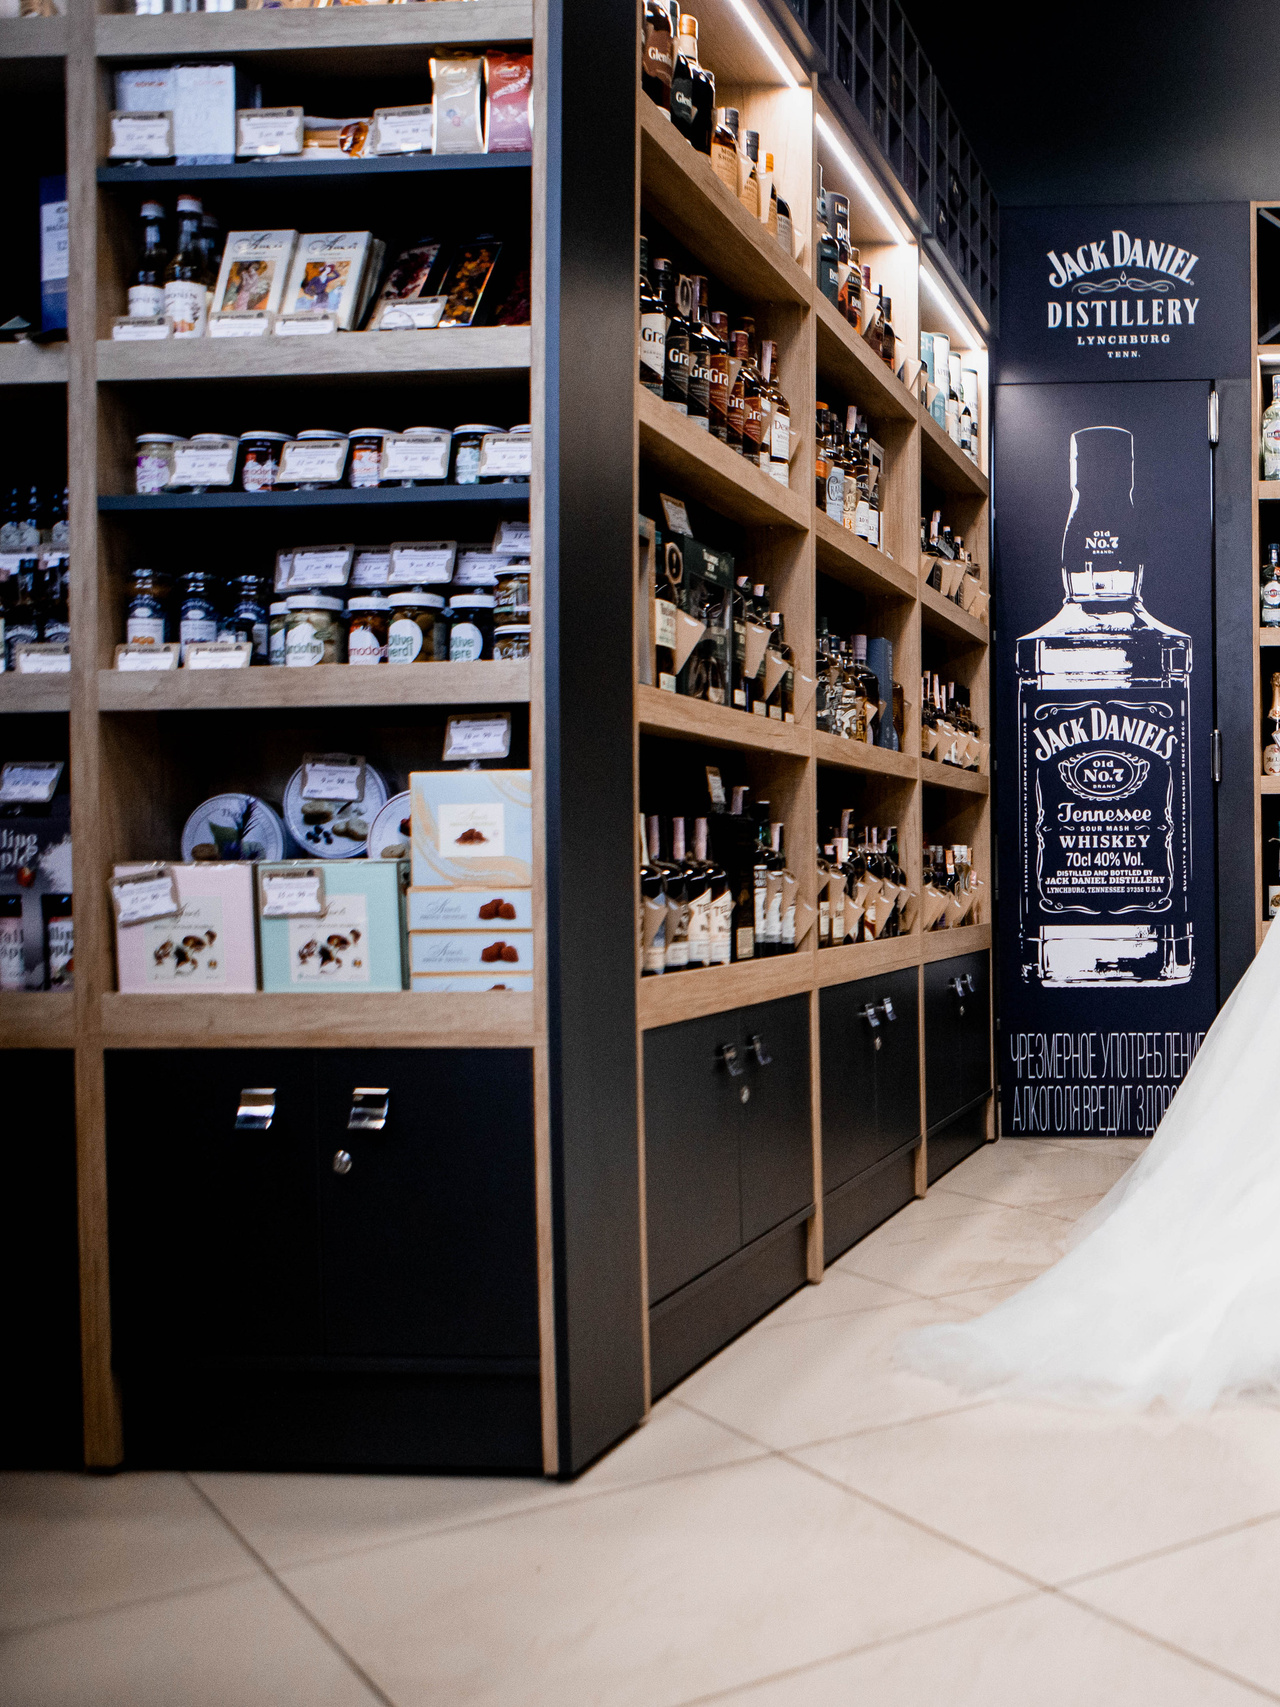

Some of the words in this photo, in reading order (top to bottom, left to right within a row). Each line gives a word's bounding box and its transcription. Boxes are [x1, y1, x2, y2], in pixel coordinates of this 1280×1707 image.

[1047, 240, 1110, 288] JACK
[1112, 230, 1200, 284] DANIEL
[1048, 298, 1200, 328] DISTILLERY
[1077, 334, 1170, 346] LYNCHBURG
[1033, 717, 1090, 761] JACK
[1090, 708, 1178, 760] DANIEL'S
[1093, 760, 1114, 768] Old
[1083, 768, 1124, 782] No.7
[1058, 802, 1152, 822] Tennessee
[1058, 834, 1151, 848] WHISKEY
[1066, 852, 1091, 867] 70cl
[1094, 852, 1120, 866] 40%
[1122, 852, 1144, 866] Vol.
[1045, 878, 1070, 886] JACK
[1071, 877, 1107, 885] DANIEL
[1109, 876, 1165, 884] DISTILLERY
[1010, 1033, 1098, 1078] ЧРЕЗМЕРНОЕ
[1012, 1086, 1080, 1131] АЛКОГОЛЯ
[1083, 1085, 1132, 1136] ВРЕДИТ
